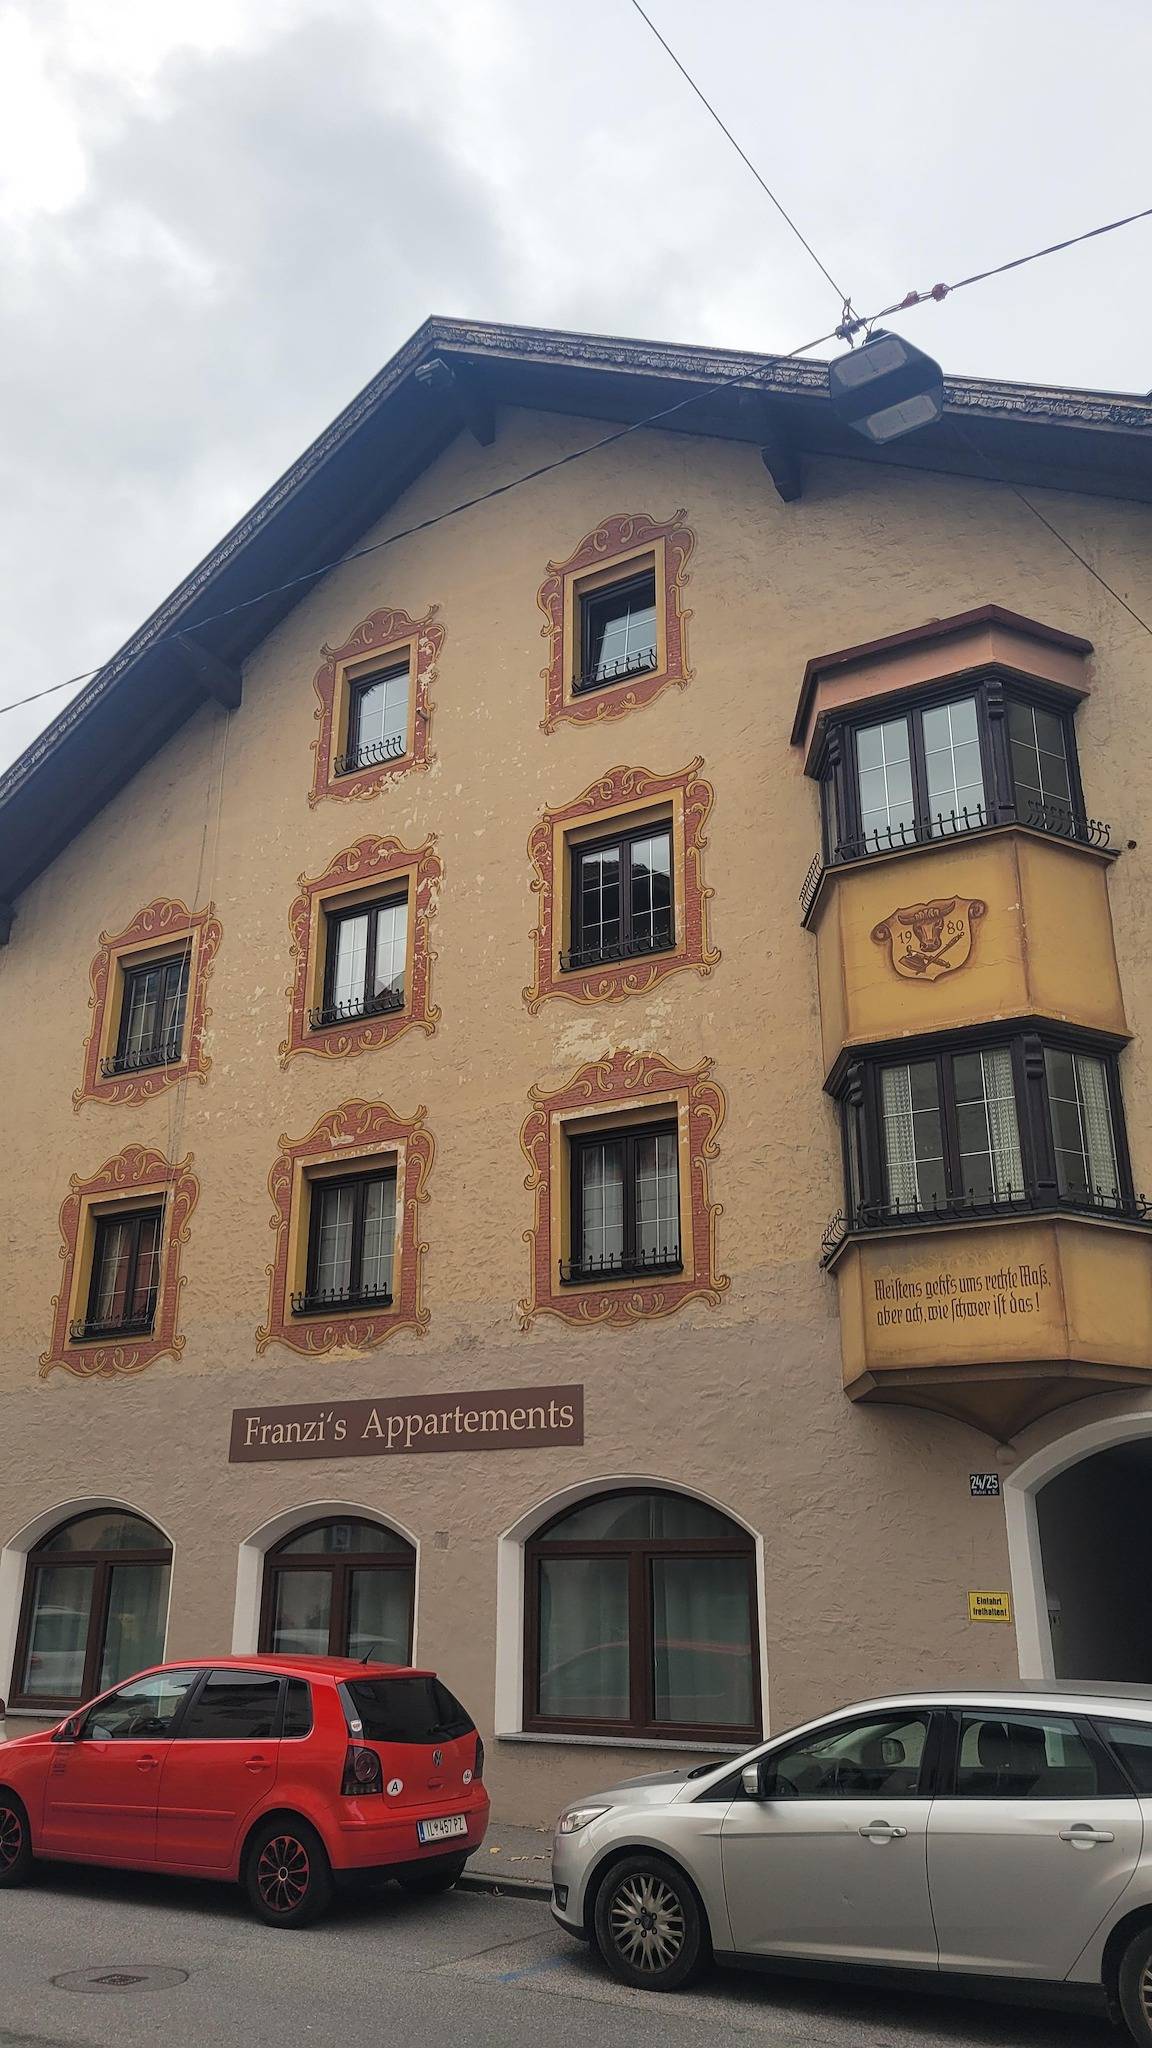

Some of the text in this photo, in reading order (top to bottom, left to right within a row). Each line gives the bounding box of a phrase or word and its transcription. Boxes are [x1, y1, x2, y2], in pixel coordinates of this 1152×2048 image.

[897, 919, 964, 945] 19 80
[959, 1277, 983, 1294] ums
[985, 1267, 1018, 1291] rechte
[877, 1304, 903, 1326] aber
[927, 1299, 949, 1321] wie
[243, 1399, 575, 1449] Franzi's Appartements
[970, 1475, 999, 1489] 24/25
[976, 1596, 1002, 1606] Einfahrt
[391, 1782, 399, 1793] A
